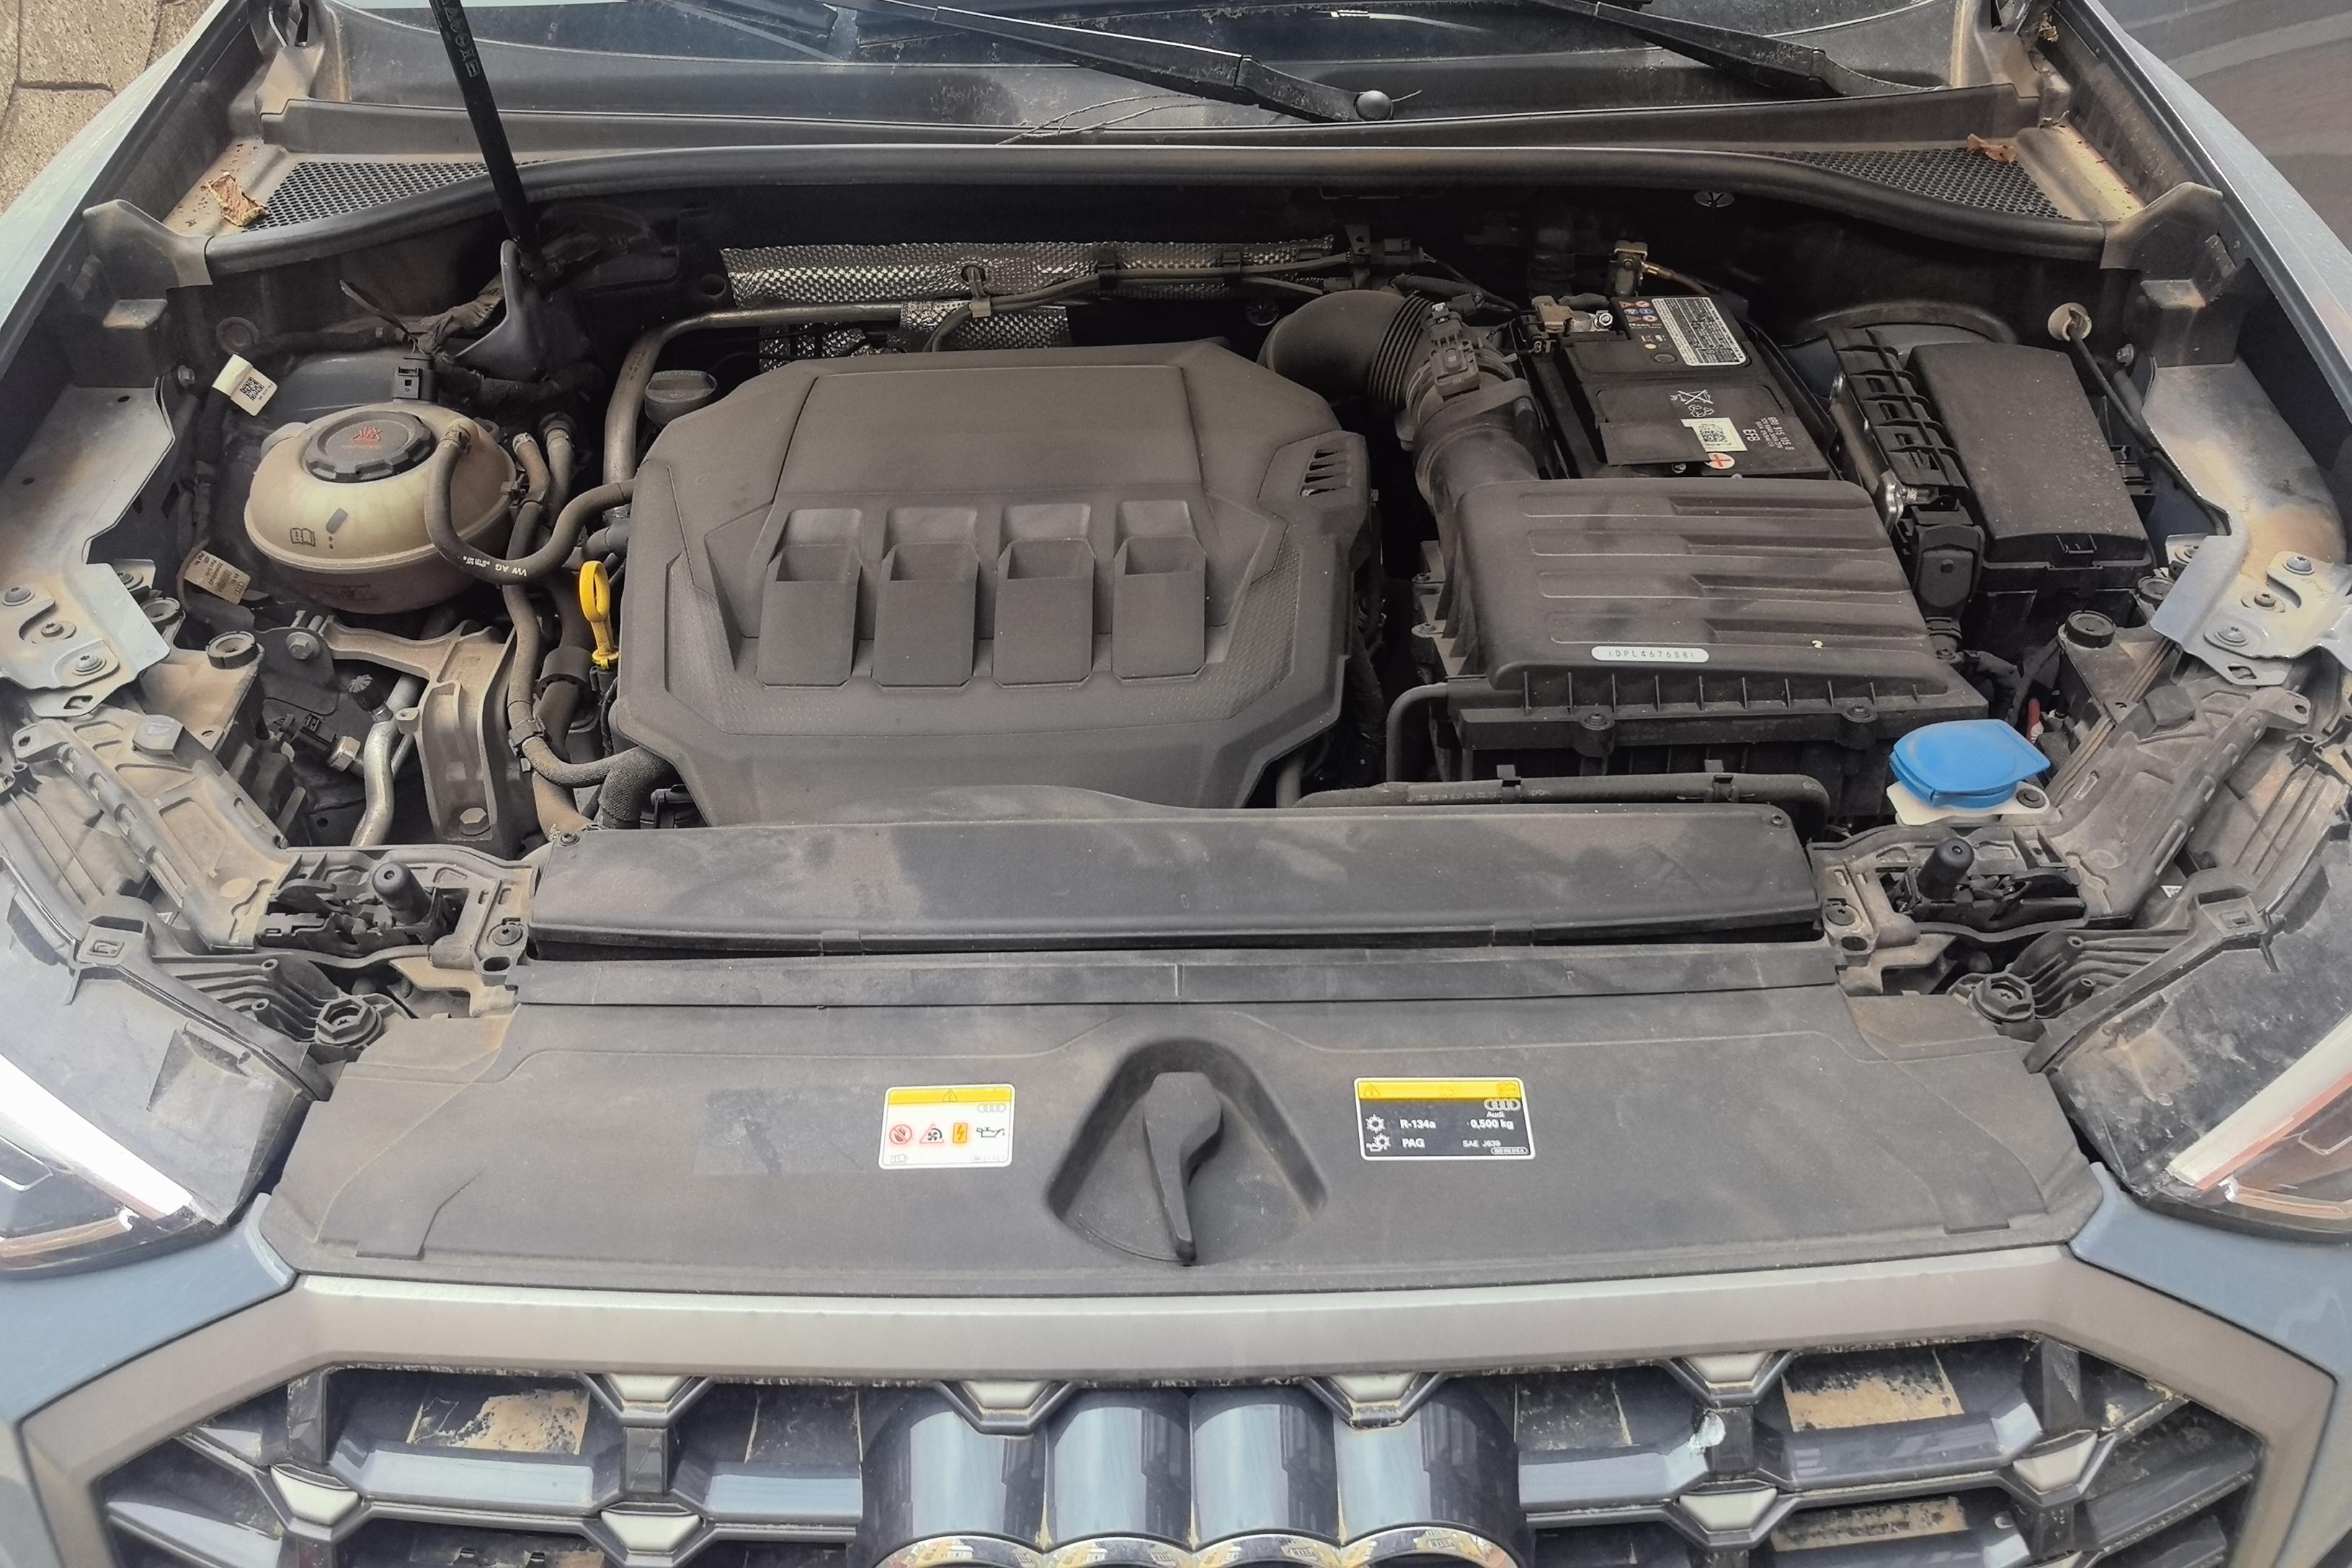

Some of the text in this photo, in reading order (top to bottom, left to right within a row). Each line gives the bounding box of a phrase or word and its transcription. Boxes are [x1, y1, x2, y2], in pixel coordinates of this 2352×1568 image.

[1742, 429, 1760, 441] EFB
[495, 564, 527, 576] VW AG
[1399, 1118, 1515, 1131] R-134a 0,500 kg
[1402, 1139, 1425, 1149] PAG
[1462, 1139, 1479, 1148] SAE
